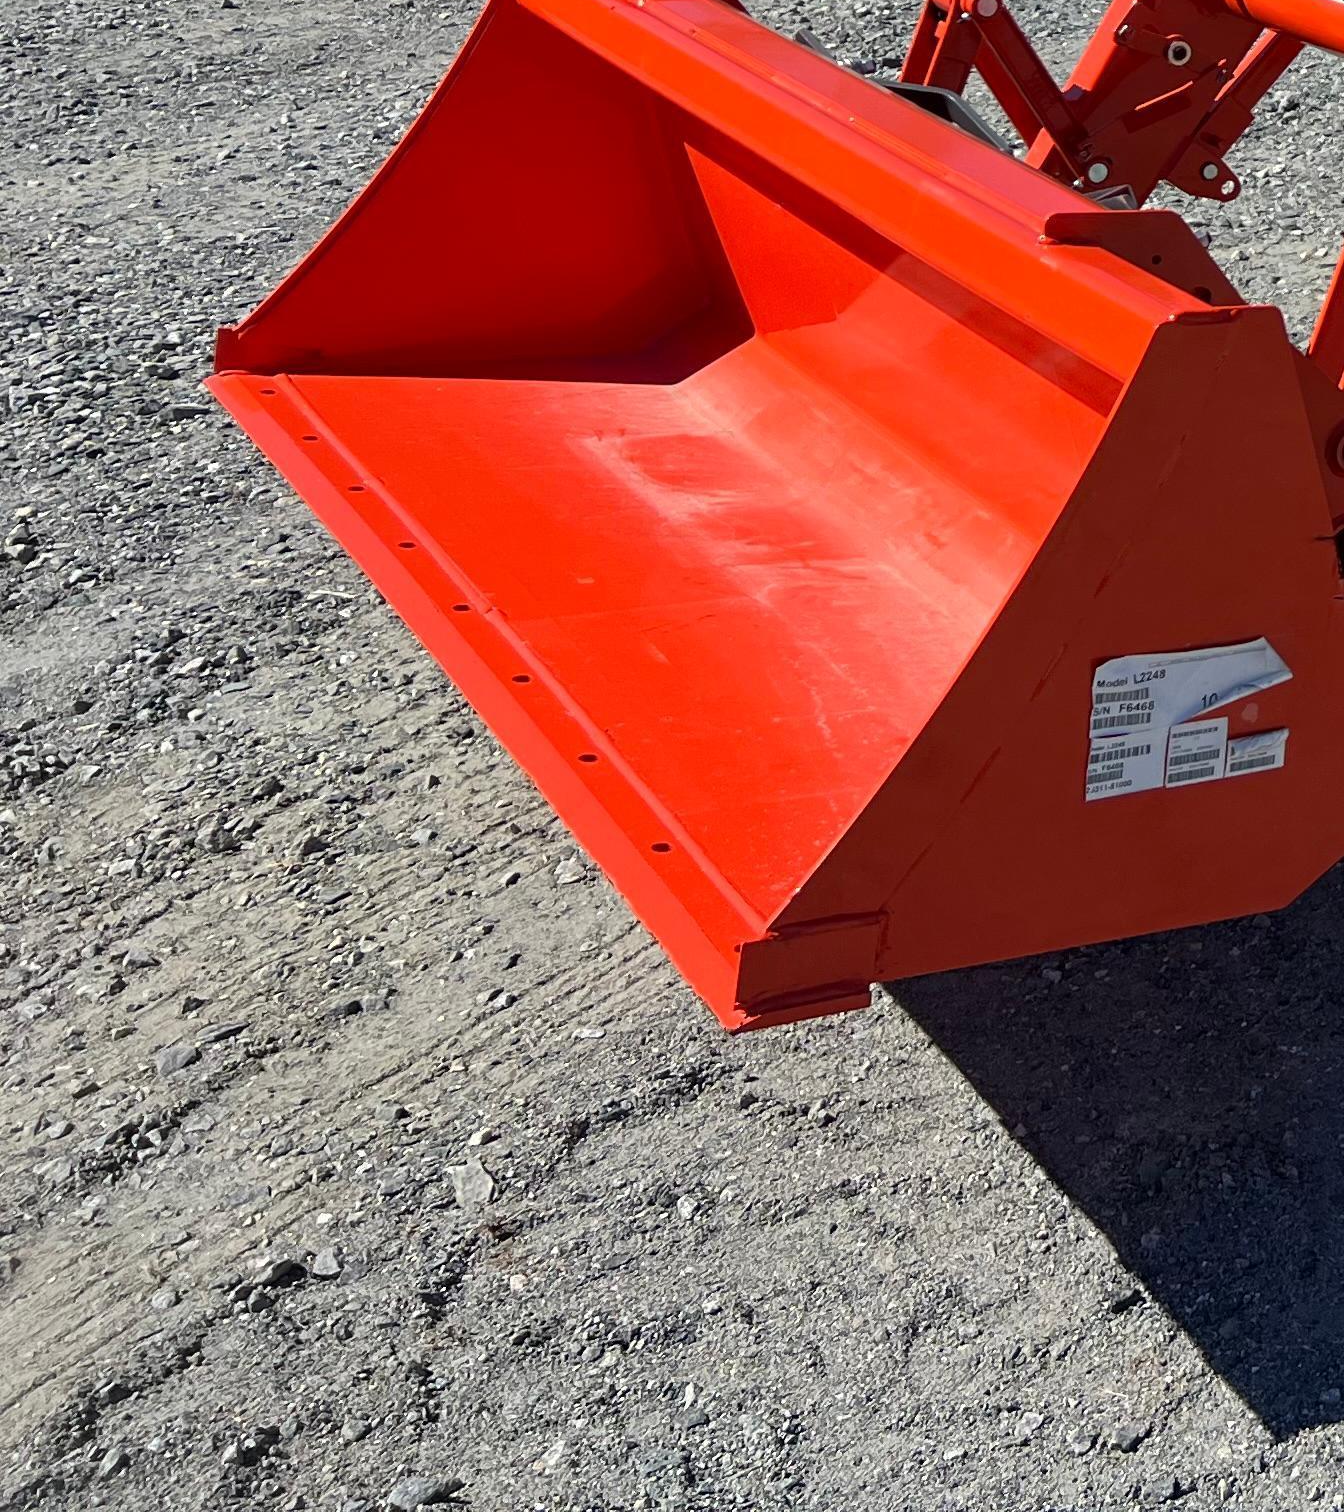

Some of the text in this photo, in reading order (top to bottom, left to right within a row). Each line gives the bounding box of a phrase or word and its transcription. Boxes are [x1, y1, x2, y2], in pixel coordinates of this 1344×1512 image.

[1096, 669, 1167, 688] Model L2248
[1093, 700, 1155, 716] S/N F6468
